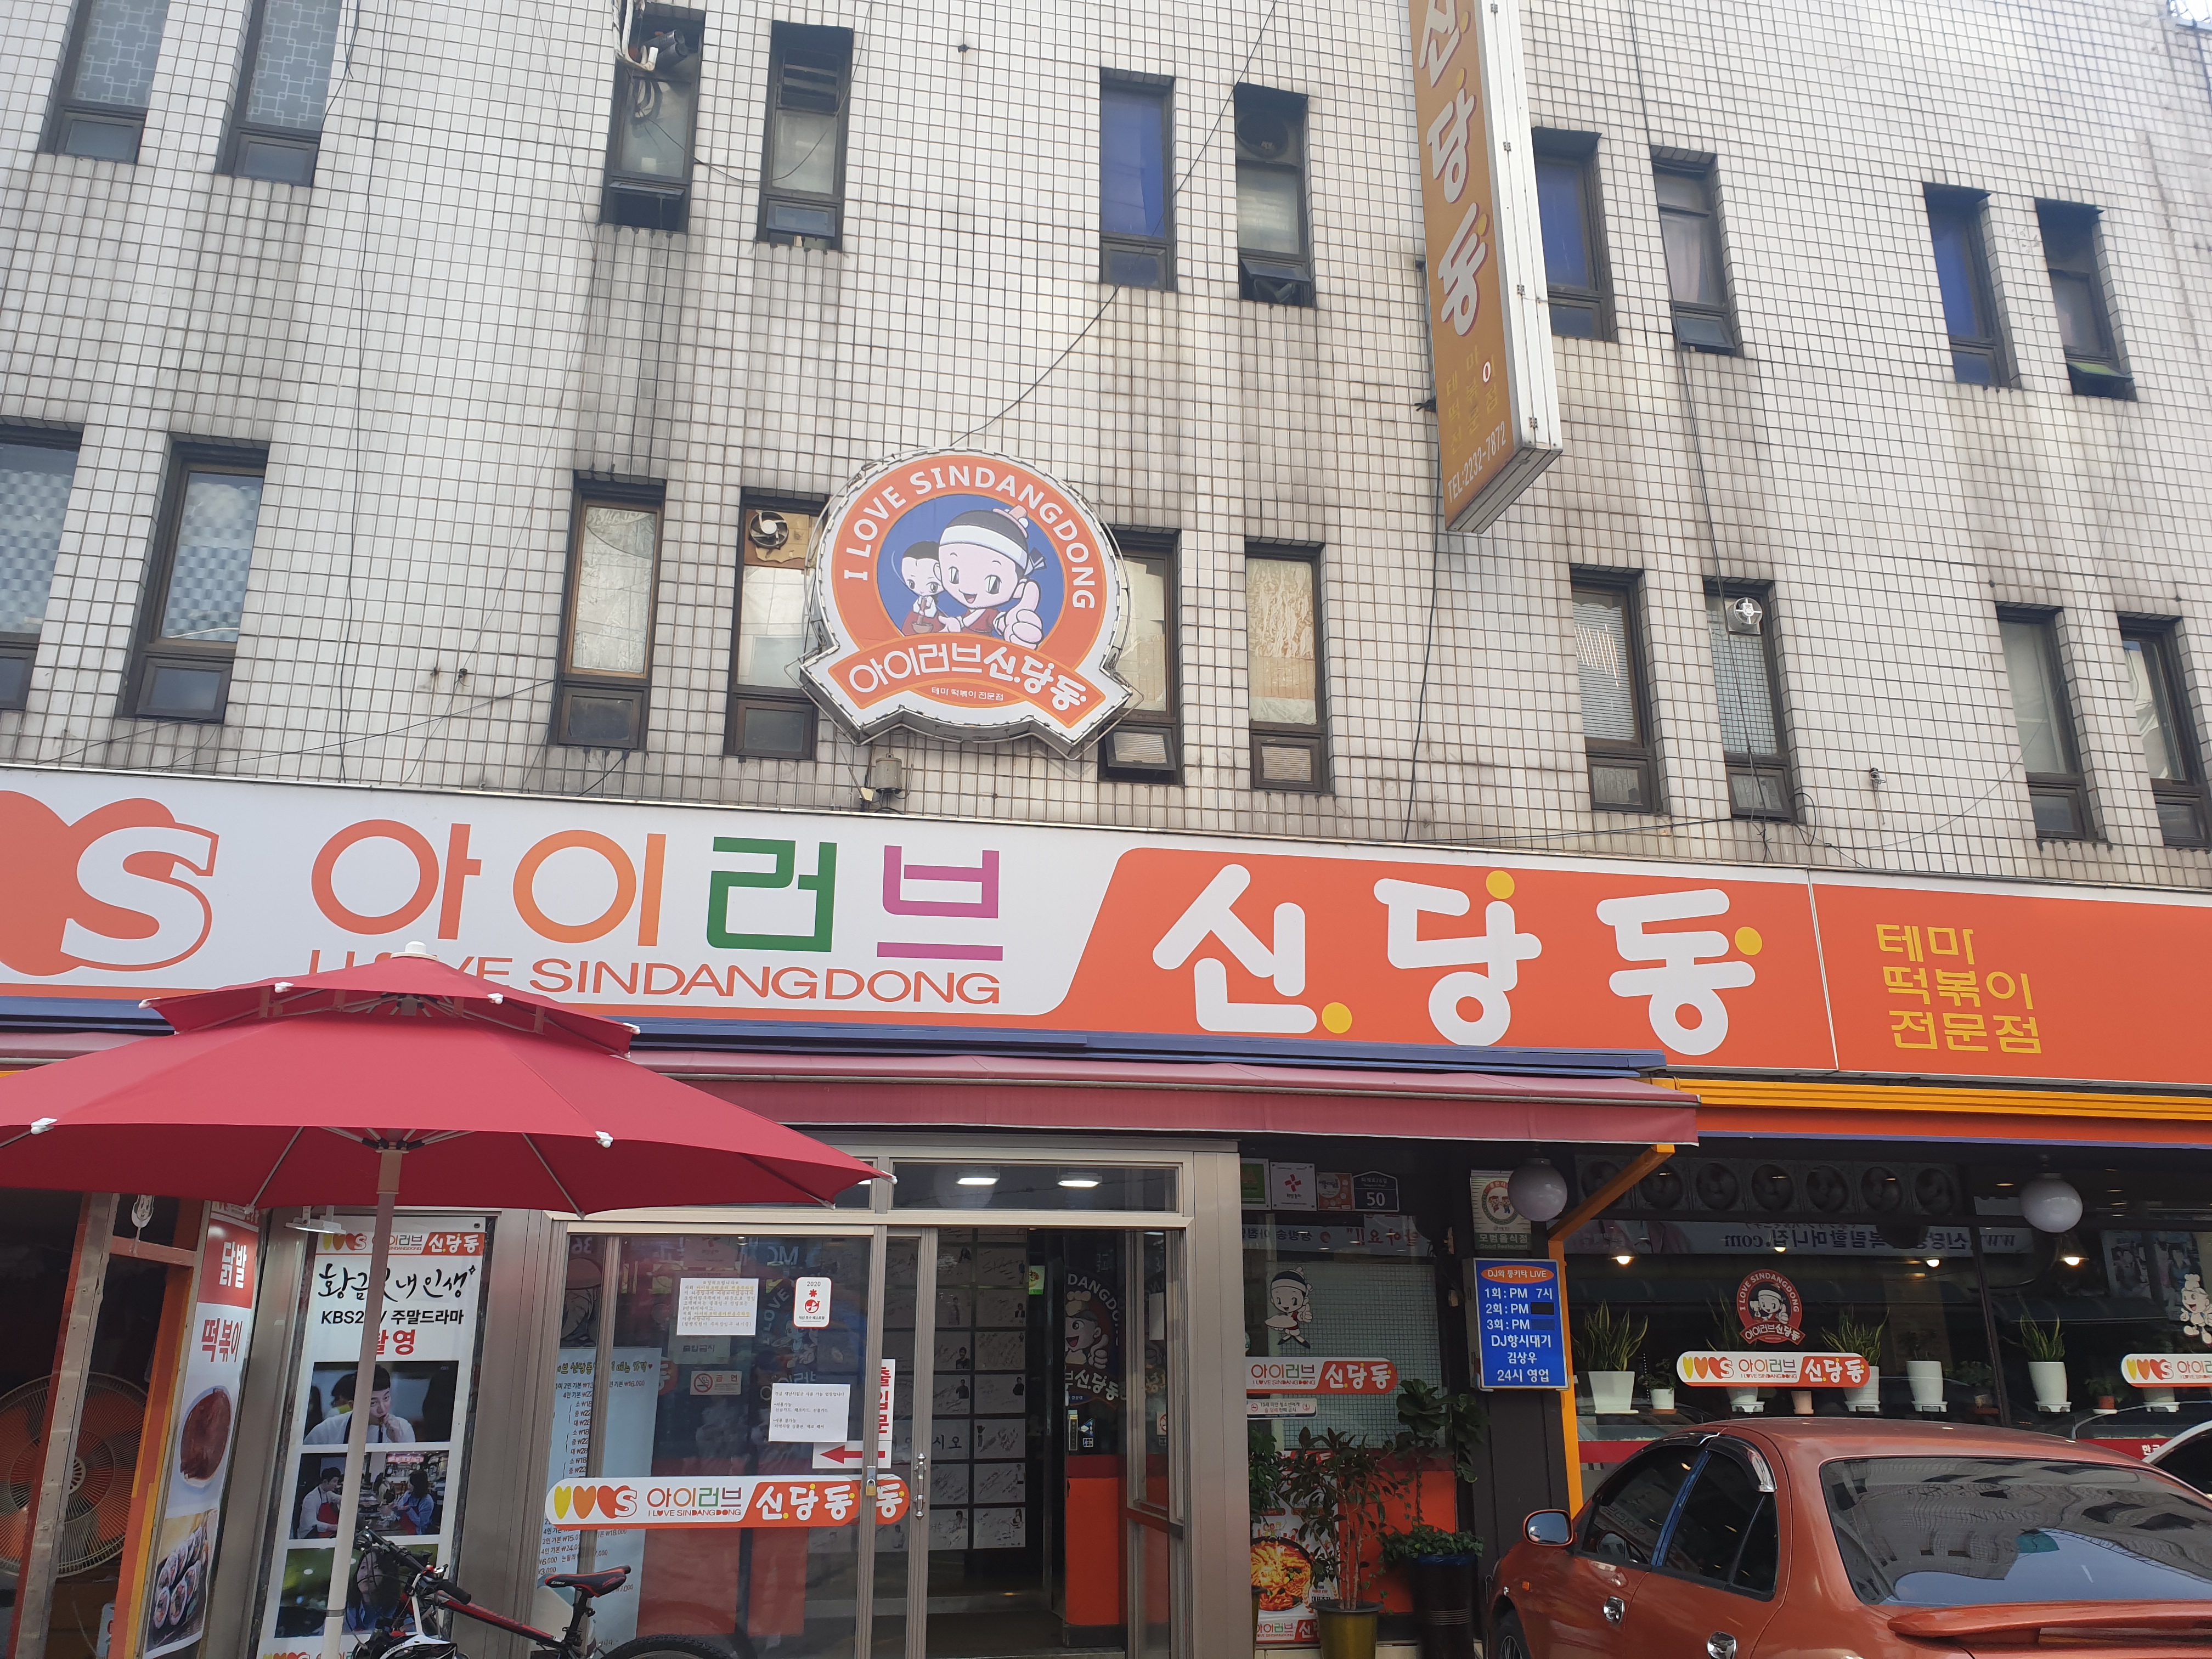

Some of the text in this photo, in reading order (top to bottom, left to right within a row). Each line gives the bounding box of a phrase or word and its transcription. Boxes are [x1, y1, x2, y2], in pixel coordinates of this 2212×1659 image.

[1447, 421, 1506, 503] TEL:2232-7872
[843, 465, 1094, 609] I LOVE SINDANGDONG
[932, 687, 1003, 701] 테마 떡볶이 전문점
[311, 819, 1763, 1056] 아이러브 신당동
[1876, 924, 1974, 964] 테마
[529, 958, 1000, 1005] SINDANGDONG
[1883, 966, 2033, 1009] 떡볶이
[1889, 1011, 2042, 1054] 전문점
[1366, 1191, 1386, 1207] 50
[428, 1233, 479, 1254] 신당동
[1479, 1233, 1528, 1244] 모범음식점
[219, 1241, 247, 1289] 닭발
[1488, 1269, 1504, 1279] DJ와
[1530, 1269, 1547, 1278] LIVE
[396, 1274, 417, 1299] 내
[1510, 1288, 1528, 1299] PM
[1536, 1288, 1553, 1300] 7시
[1739, 1280, 1751, 1305] LOVE
[1750, 1272, 1799, 1312] SINDANGDONG
[391, 1309, 464, 1325] 주말드라마
[1510, 1304, 1529, 1314] PM
[1511, 1319, 1530, 1330] PM
[201, 1318, 243, 1363] 떡볶이
[1491, 1334, 1551, 1348] DJ항시대기
[1507, 1352, 1537, 1365] 김상우
[1738, 1358, 1866, 1383] 아이러브 신당동
[1251, 1362, 1392, 1390] 아이러브 신당동
[1497, 1369, 1550, 1383] 24시 영업
[646, 1483, 855, 1520] 아이러브 신당동
[676, 1509, 742, 1517] SINDANGDONG
